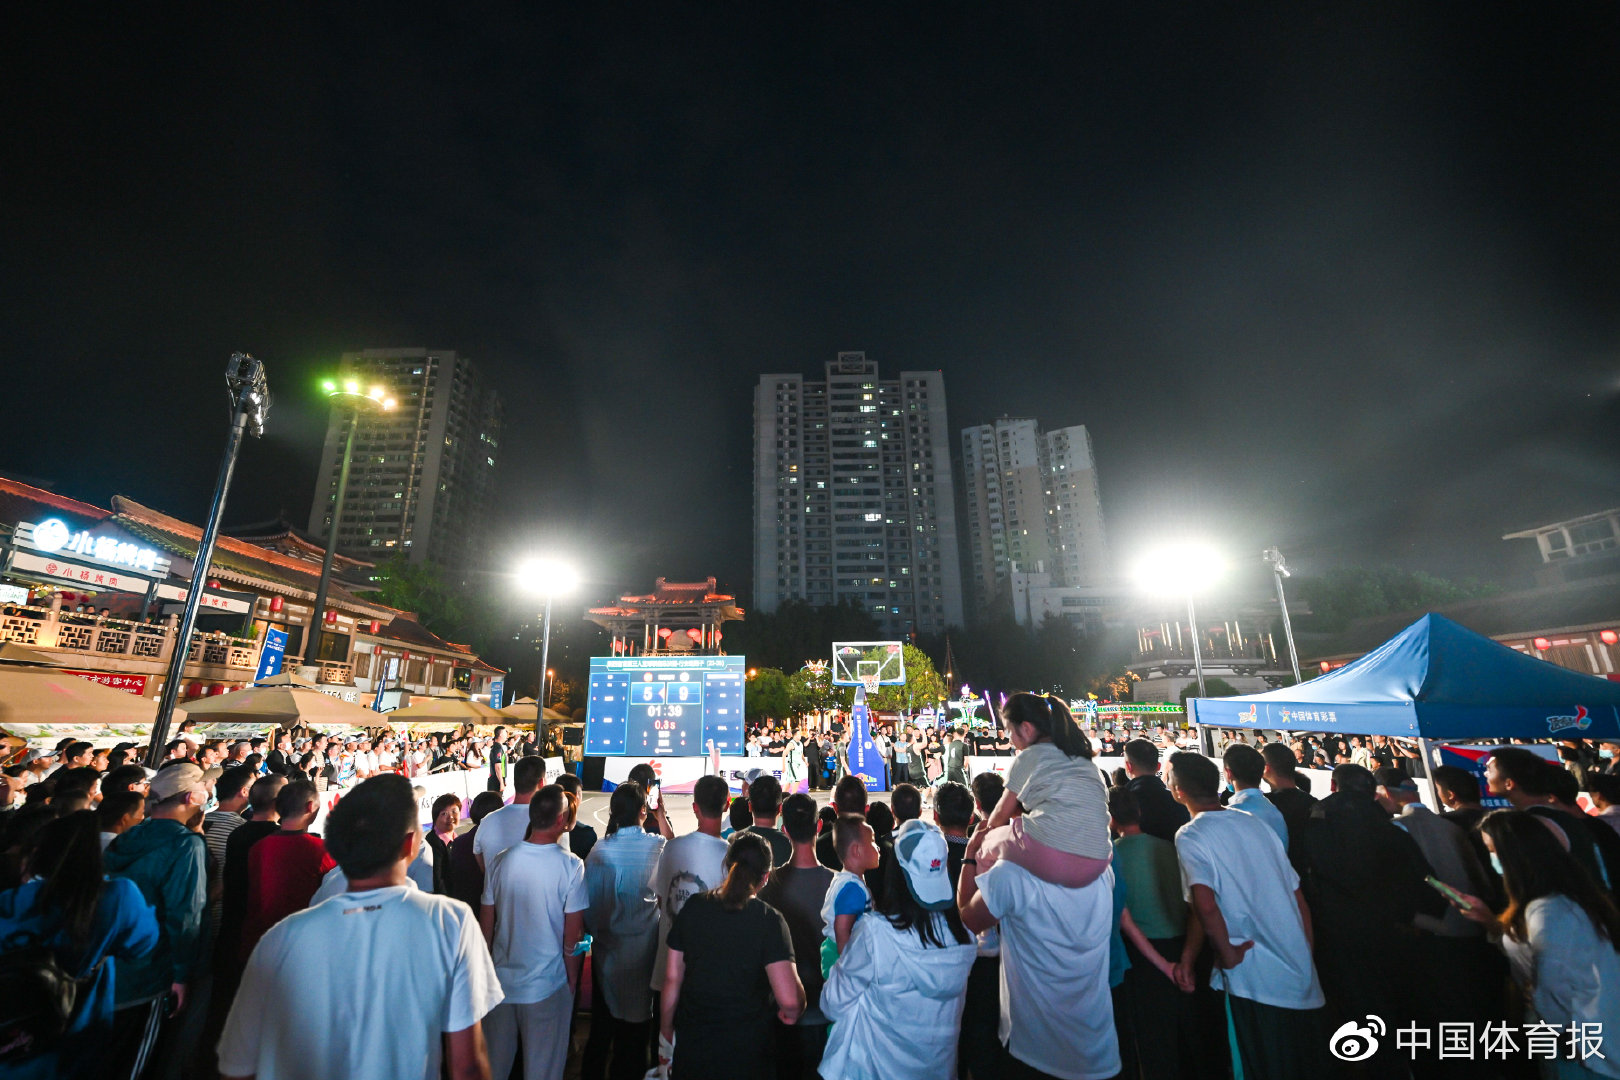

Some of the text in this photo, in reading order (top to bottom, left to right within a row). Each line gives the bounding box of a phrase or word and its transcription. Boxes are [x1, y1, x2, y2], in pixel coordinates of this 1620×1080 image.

[643, 686, 653, 701] 5
[678, 685, 689, 701] 9
[647, 704, 683, 717] 01:39
[1291, 711, 1337, 722] 中国体育彩票
